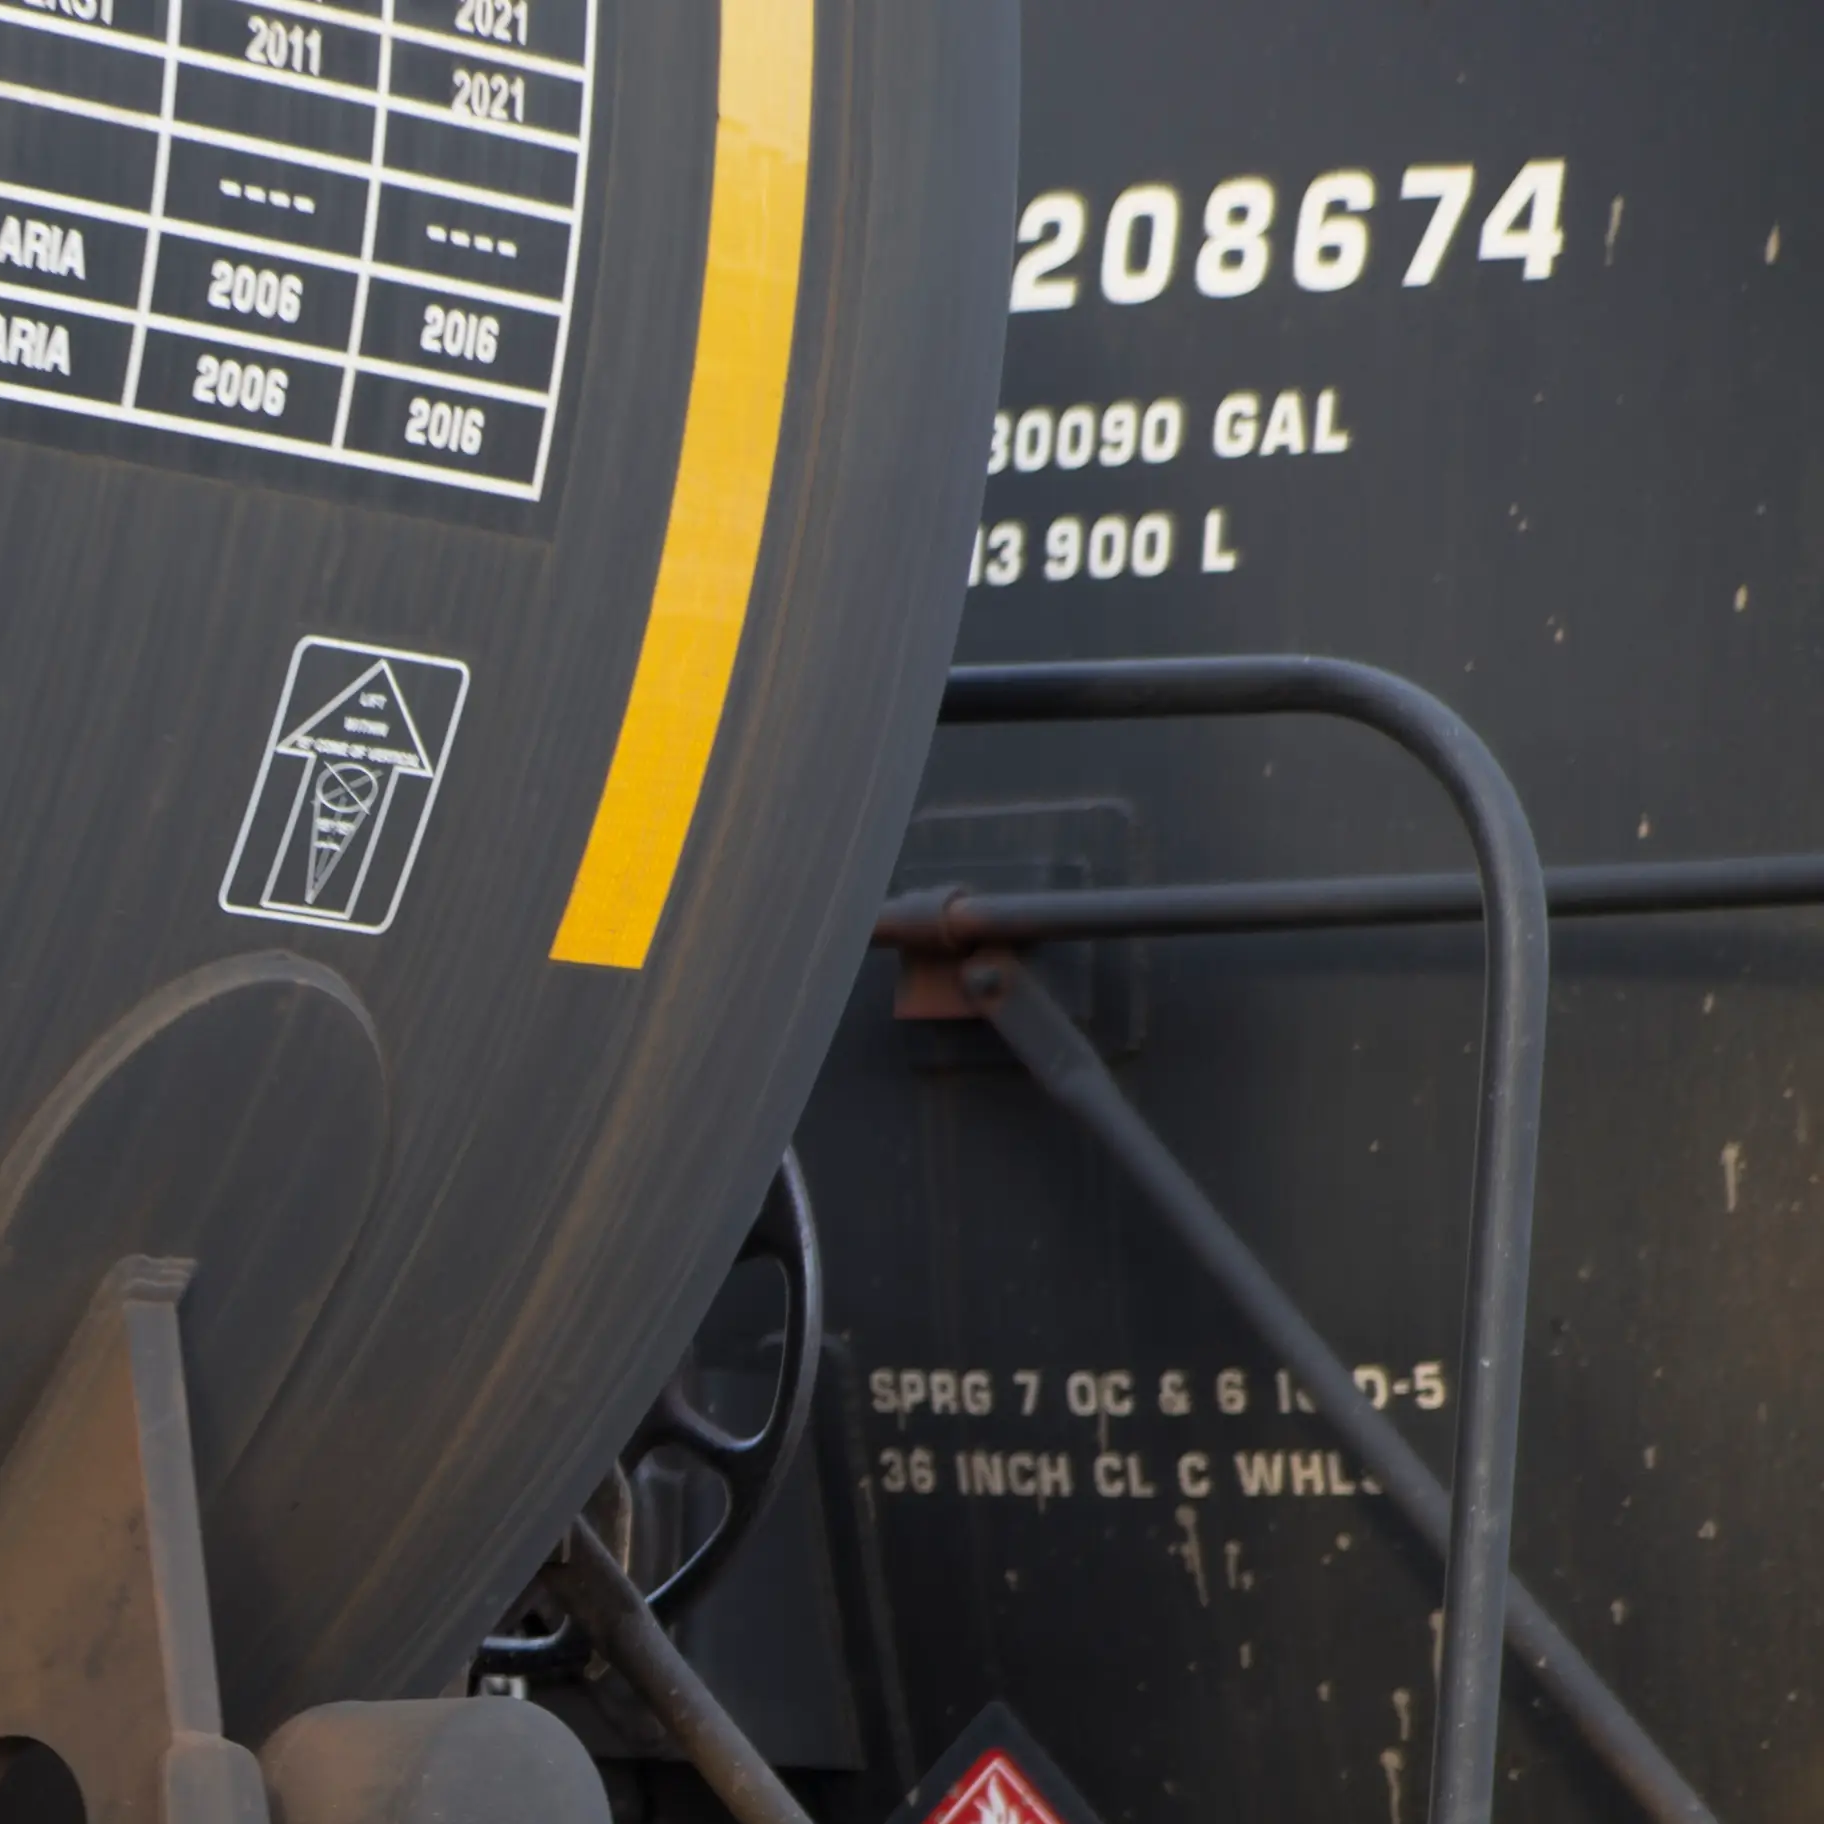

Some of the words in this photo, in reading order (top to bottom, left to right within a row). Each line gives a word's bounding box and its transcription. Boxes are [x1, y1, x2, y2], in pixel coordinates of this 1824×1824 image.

[245, 15, 322, 76] 2011
[453, 69, 525, 122] 2021
[1009, 158, 1566, 313] 208674
[207, 259, 303, 324] 2006
[420, 304, 500, 364] 2016
[192, 353, 289, 417] 2006
[405, 397, 485, 456] 2016
[1213, 390, 1349, 459] GAL
[1044, 514, 1170, 580] 900
[1201, 509, 1238, 573] L
[870, 1370, 992, 1414] SPRG
[1013, 1370, 1040, 1414] 7
[1066, 1369, 1136, 1414] OC
[1158, 1368, 1192, 1414] &
[1214, 1367, 1247, 1414] 6
[880, 1451, 935, 1495] 36
[957, 1450, 1072, 1496] INCH
[1095, 1450, 1153, 1496] CL
[1179, 1448, 1211, 1496] C
